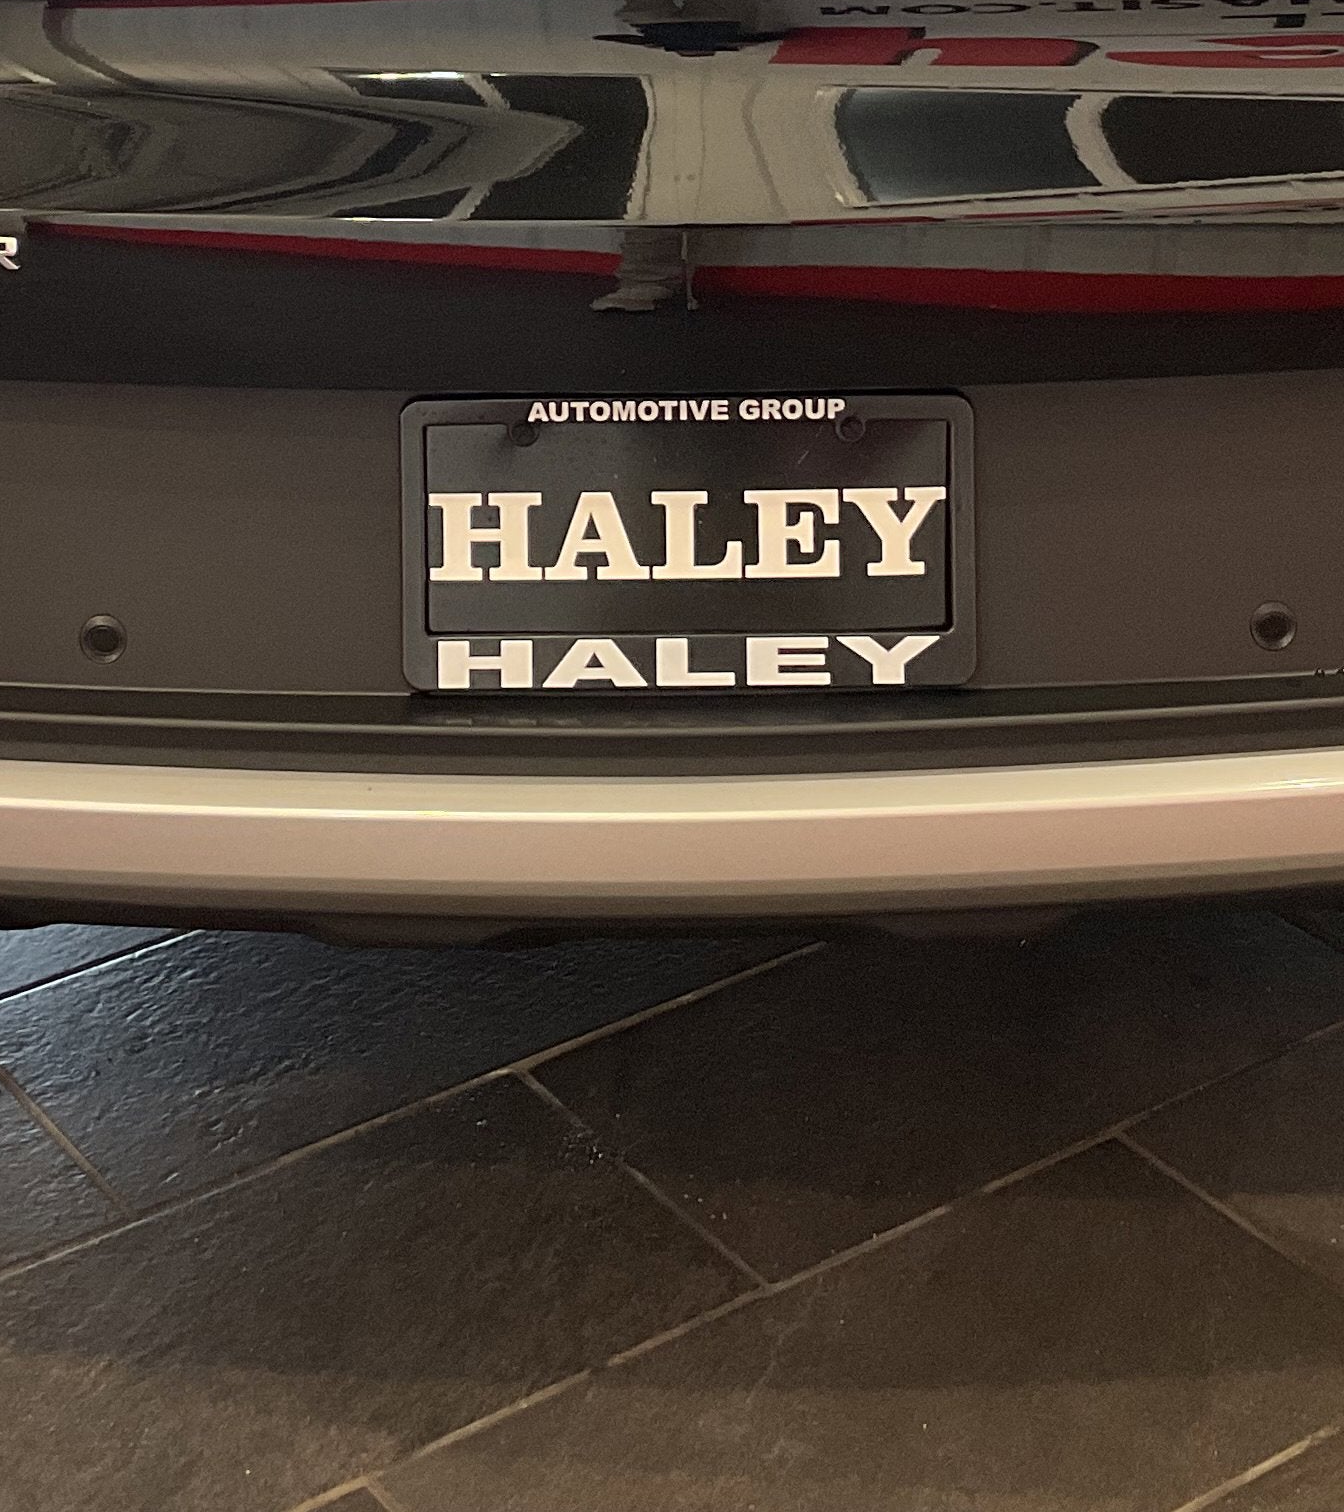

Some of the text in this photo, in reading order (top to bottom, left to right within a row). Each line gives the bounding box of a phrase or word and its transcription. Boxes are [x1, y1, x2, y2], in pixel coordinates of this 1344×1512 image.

[528, 398, 846, 422] AUTOMOTIVE GROUP
[429, 486, 946, 581] HALEY
[437, 635, 940, 689] HALEY
